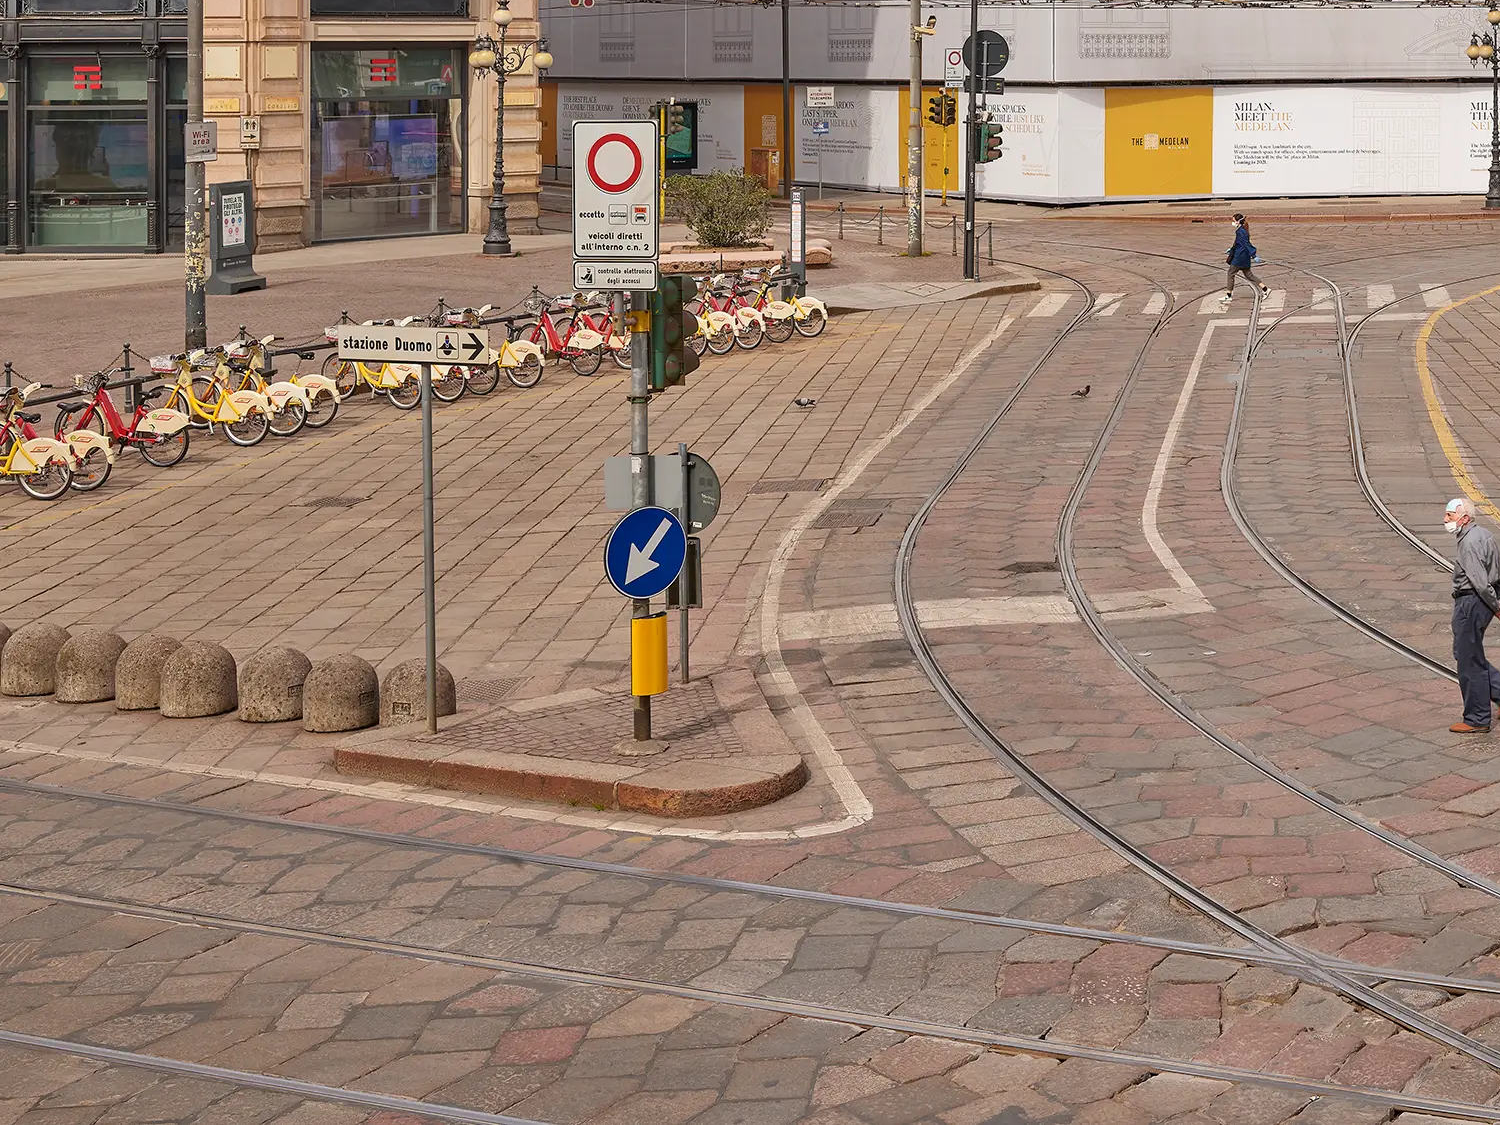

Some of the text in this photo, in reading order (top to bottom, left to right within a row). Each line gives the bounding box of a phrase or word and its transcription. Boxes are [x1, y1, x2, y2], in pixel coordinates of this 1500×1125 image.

[1002, 105, 1026, 114] SPACES
[1014, 115, 1029, 123] JUST
[1030, 115, 1045, 124] LIKE
[1234, 112, 1293, 121] MEET THE
[192, 130, 210, 138] Wi-Fi
[1132, 137, 1189, 146] THE MEDELAN
[579, 210, 605, 219] eccetto
[588, 232, 643, 240] veicoli diretti
[581, 242, 650, 251] all'interno c.n. 2
[624, 267, 653, 275] elettronico
[607, 277, 621, 285] degli
[343, 336, 433, 352] stazione Duomo
